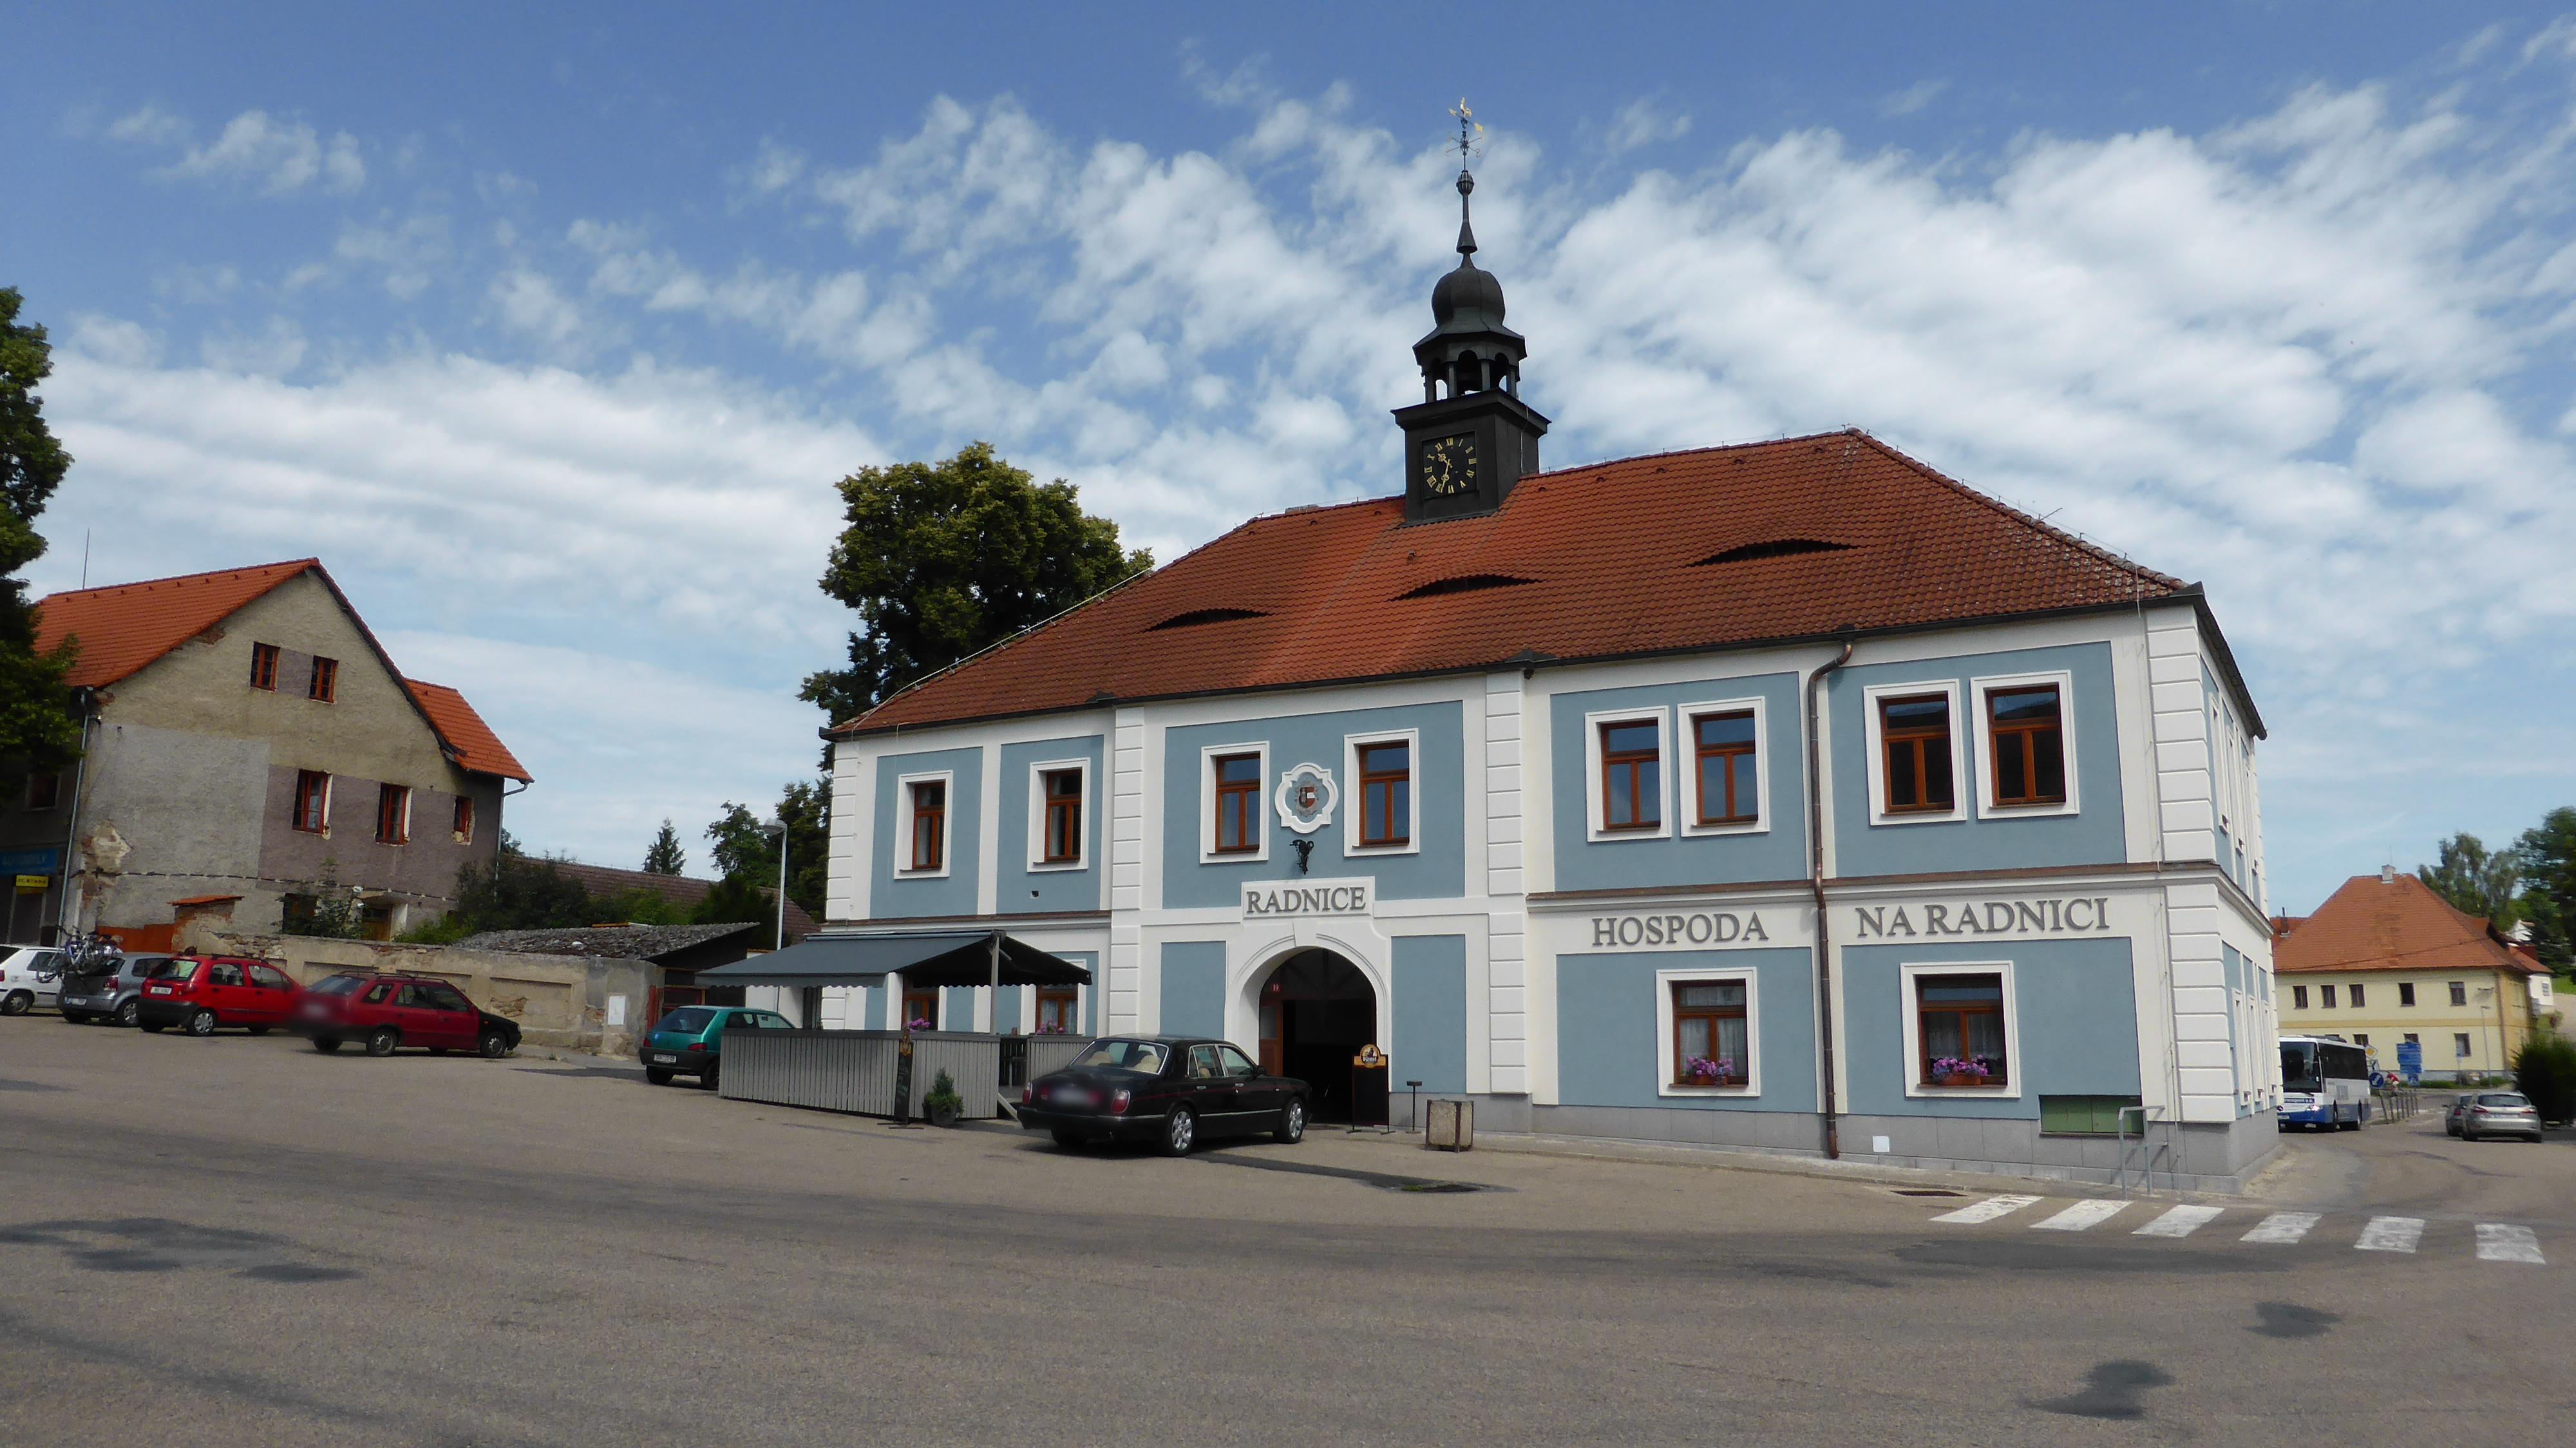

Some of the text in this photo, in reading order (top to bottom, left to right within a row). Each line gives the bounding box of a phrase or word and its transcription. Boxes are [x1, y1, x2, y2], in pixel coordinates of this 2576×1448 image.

[1246, 886, 1366, 914] RADNICE
[1855, 898, 2110, 937] NA RADNICI
[1592, 911, 1769, 946] HOSPODA
